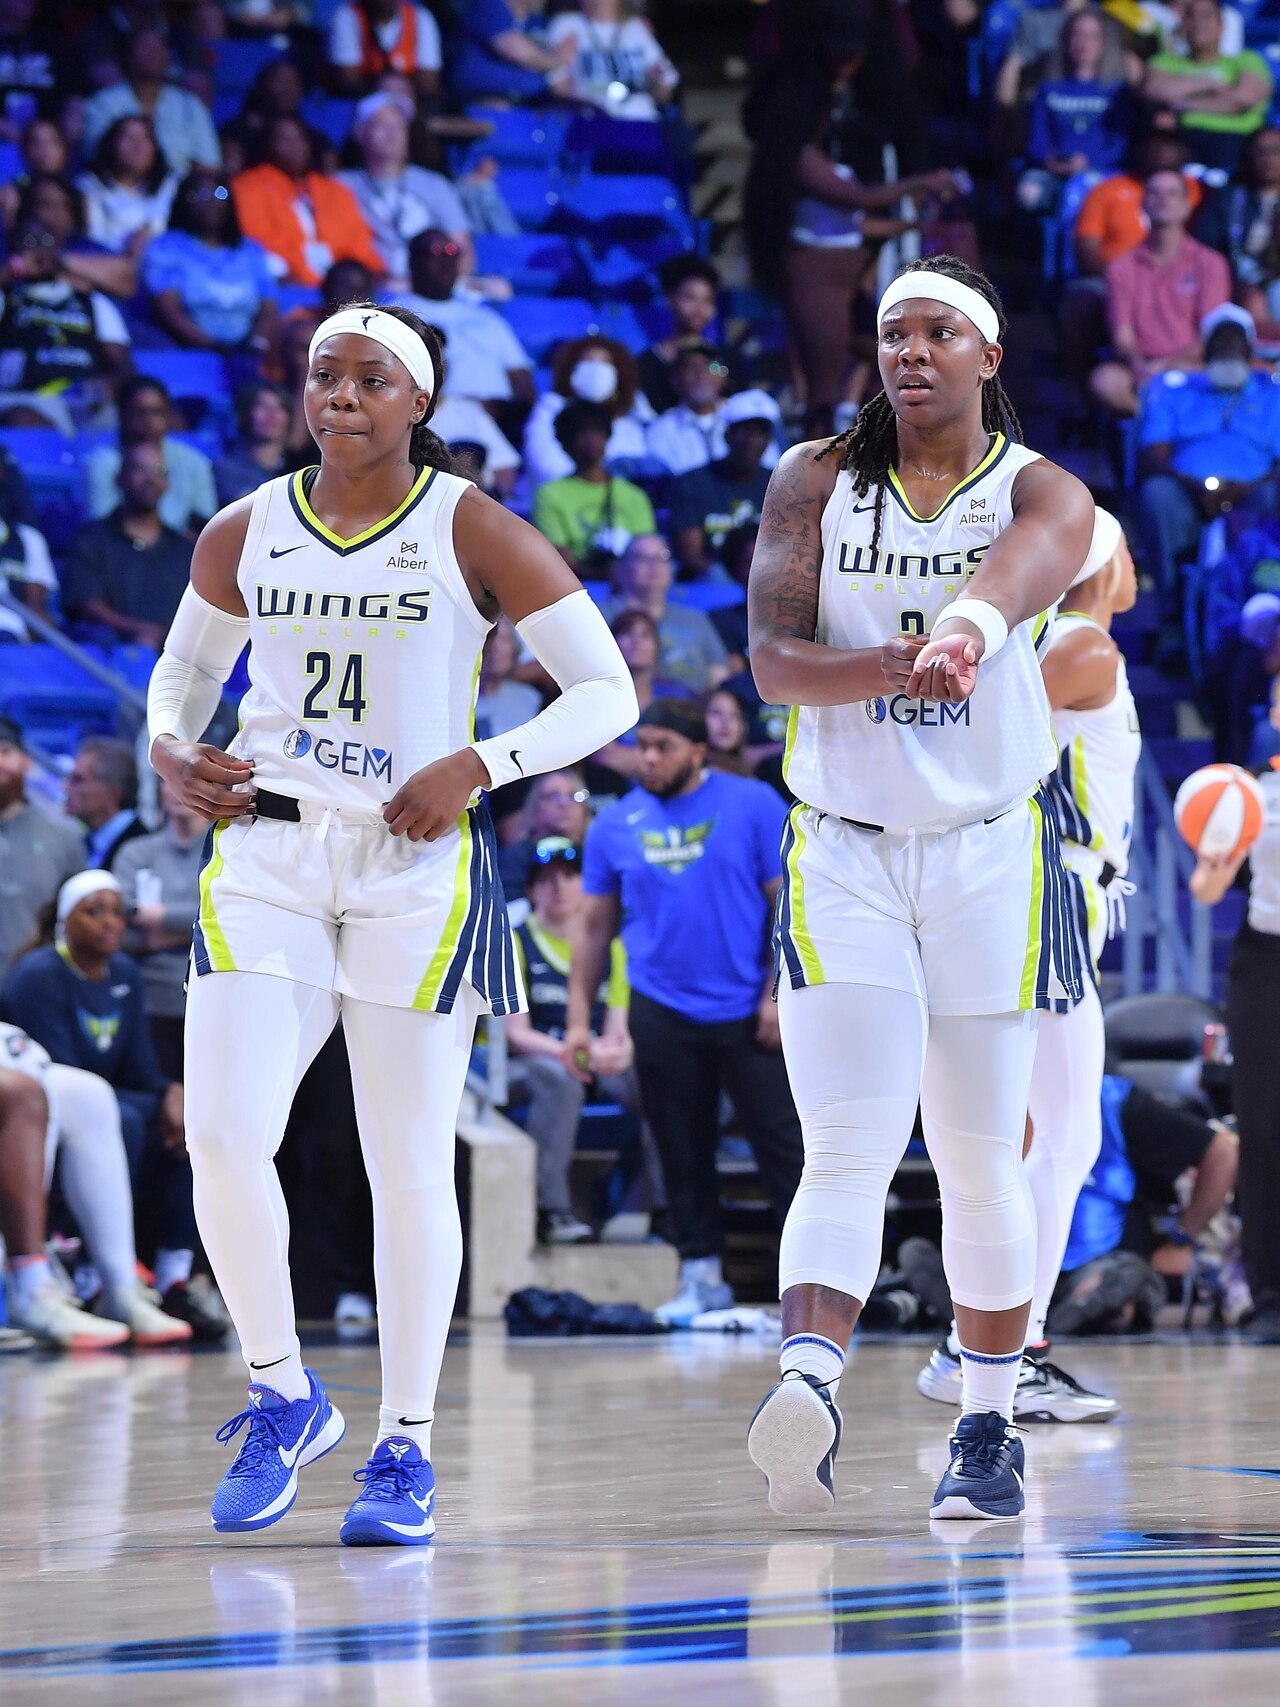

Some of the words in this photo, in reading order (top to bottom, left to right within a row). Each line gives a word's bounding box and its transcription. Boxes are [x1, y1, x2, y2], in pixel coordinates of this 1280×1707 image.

[959, 512, 997, 526] Albert
[386, 556, 429, 570] Albert
[850, 581, 956, 595] DALLA
[255, 583, 433, 625] WINGS
[269, 625, 408, 640] DALLAS
[301, 648, 370, 726] 24
[889, 693, 970, 727] GEM
[313, 738, 393, 784] GEM
